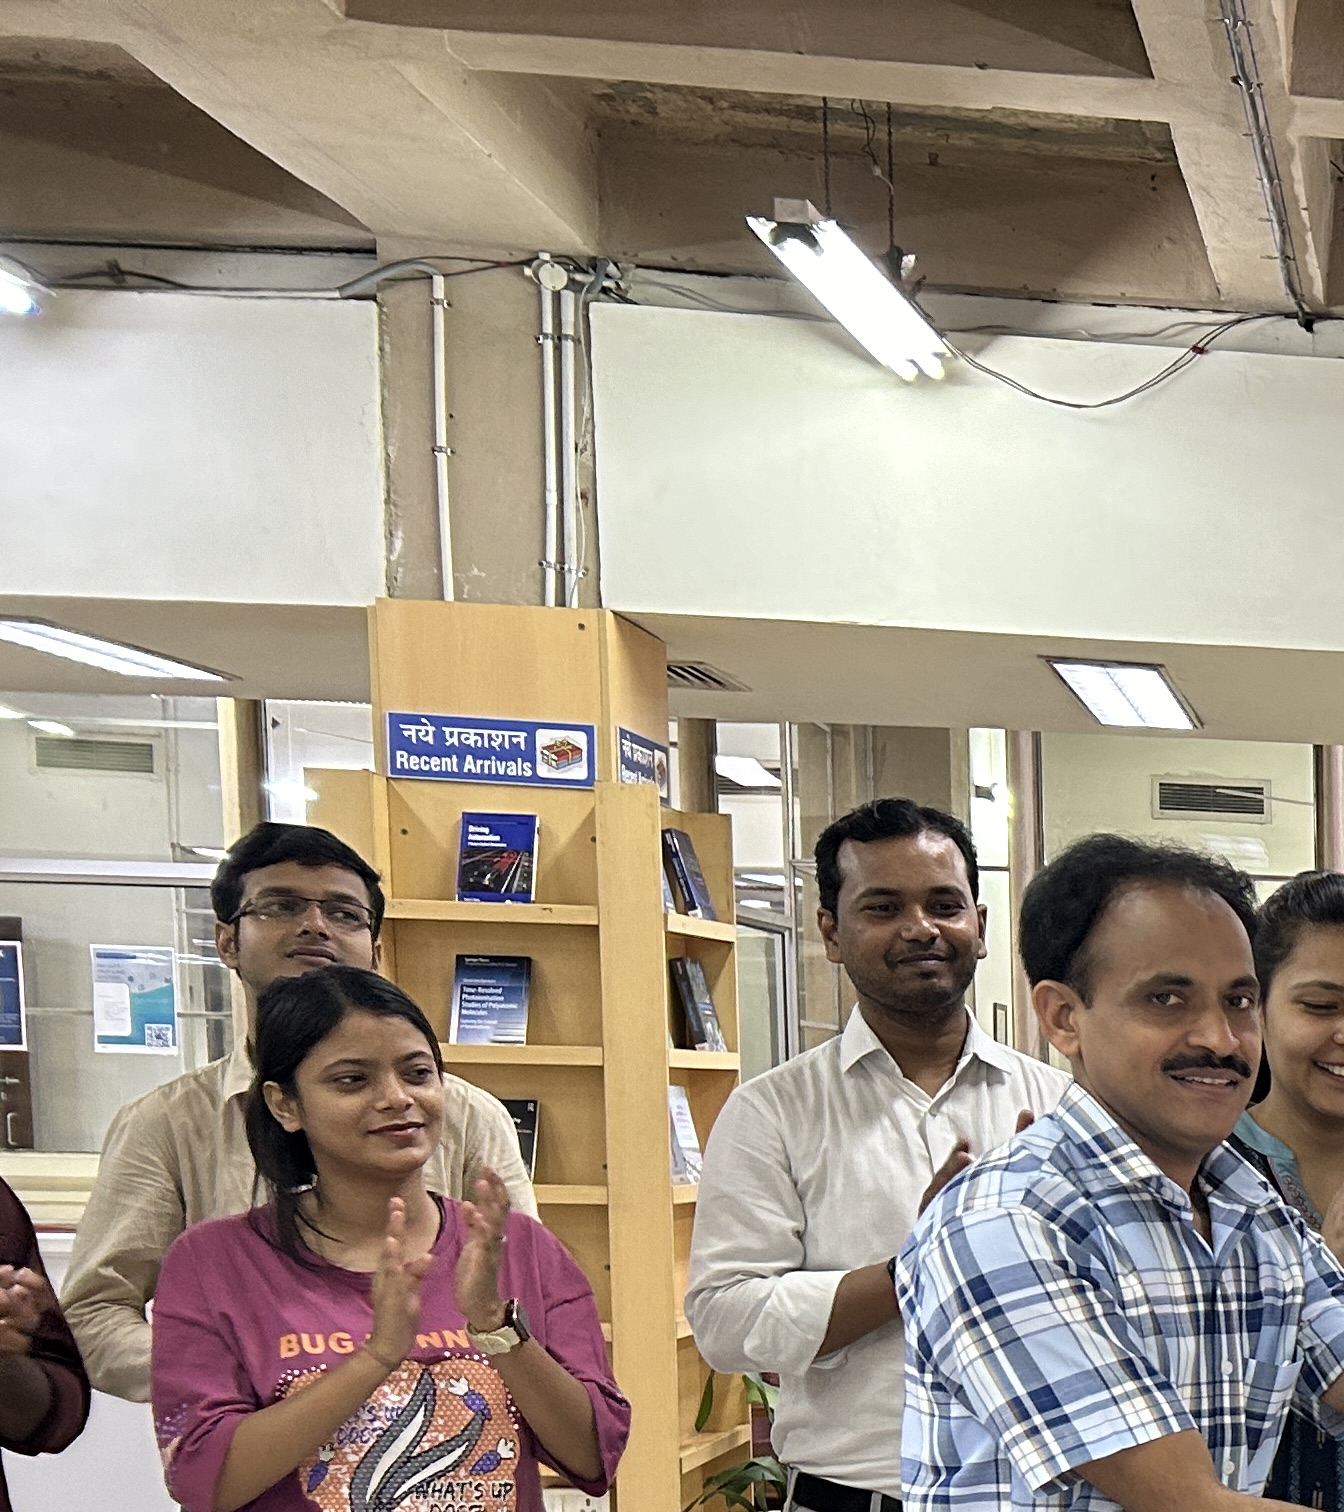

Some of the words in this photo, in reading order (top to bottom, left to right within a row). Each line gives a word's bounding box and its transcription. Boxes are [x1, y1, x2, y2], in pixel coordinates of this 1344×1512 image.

[400, 718, 436, 746] नये
[442, 726, 528, 752] प्रकाशन
[395, 751, 458, 773] Recent
[463, 755, 533, 777] Arrivals
[280, 1332, 371, 1359] BUG
[415, 1481, 484, 1500] WHAT'S
[492, 1482, 514, 1500] UP
